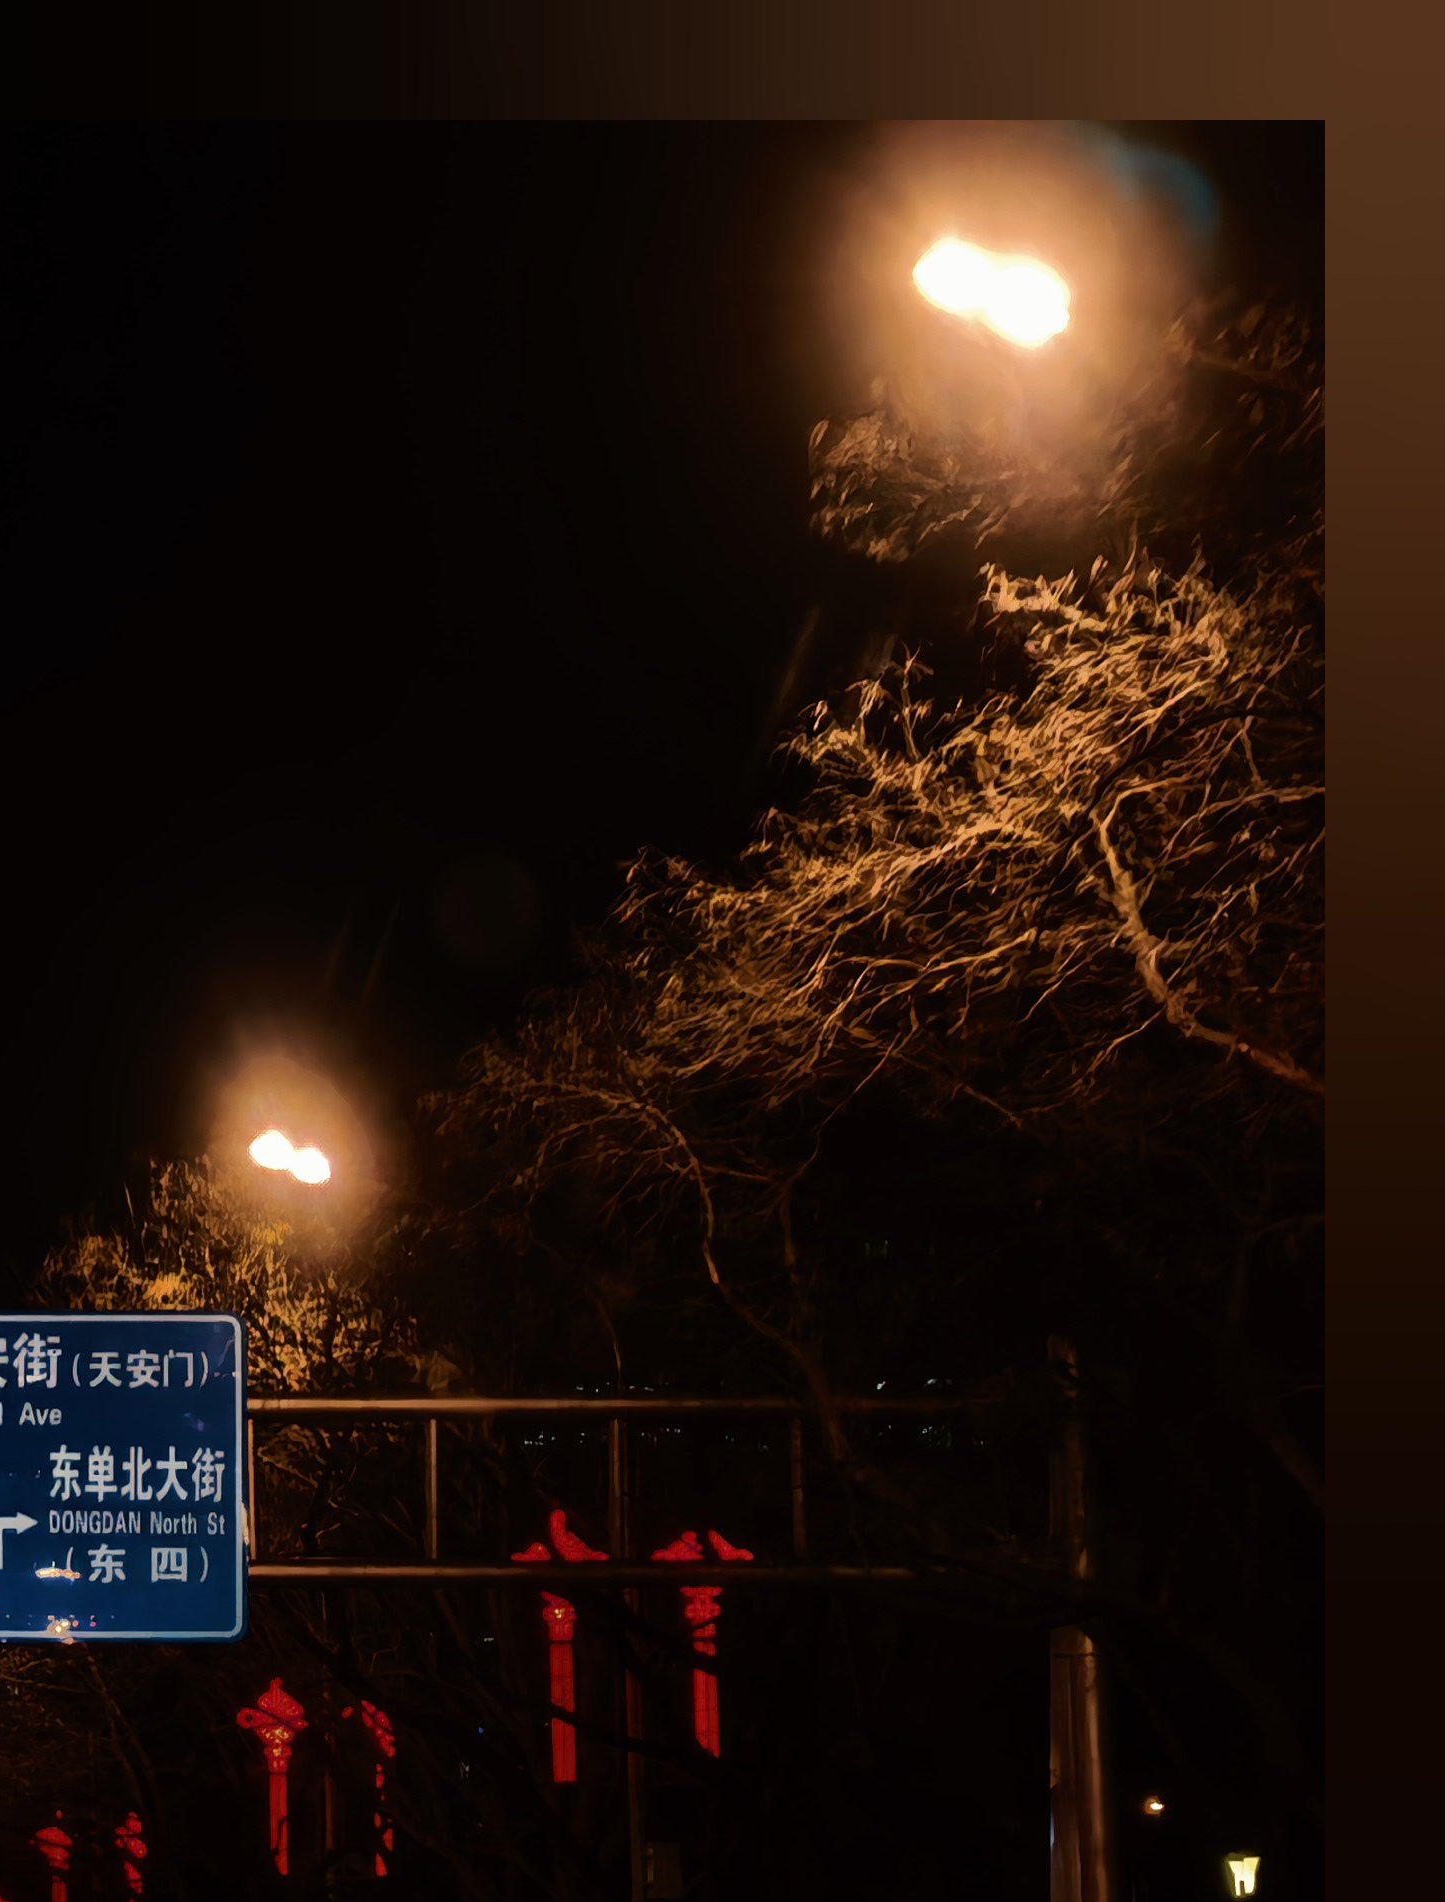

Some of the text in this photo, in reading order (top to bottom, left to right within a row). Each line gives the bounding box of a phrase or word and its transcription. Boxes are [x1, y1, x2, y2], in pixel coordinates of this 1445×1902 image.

[19, 1402, 62, 1426] Ave
[49, 1444, 226, 1503] 东单北大街
[49, 1509, 226, 1535] DONGDAN North St
